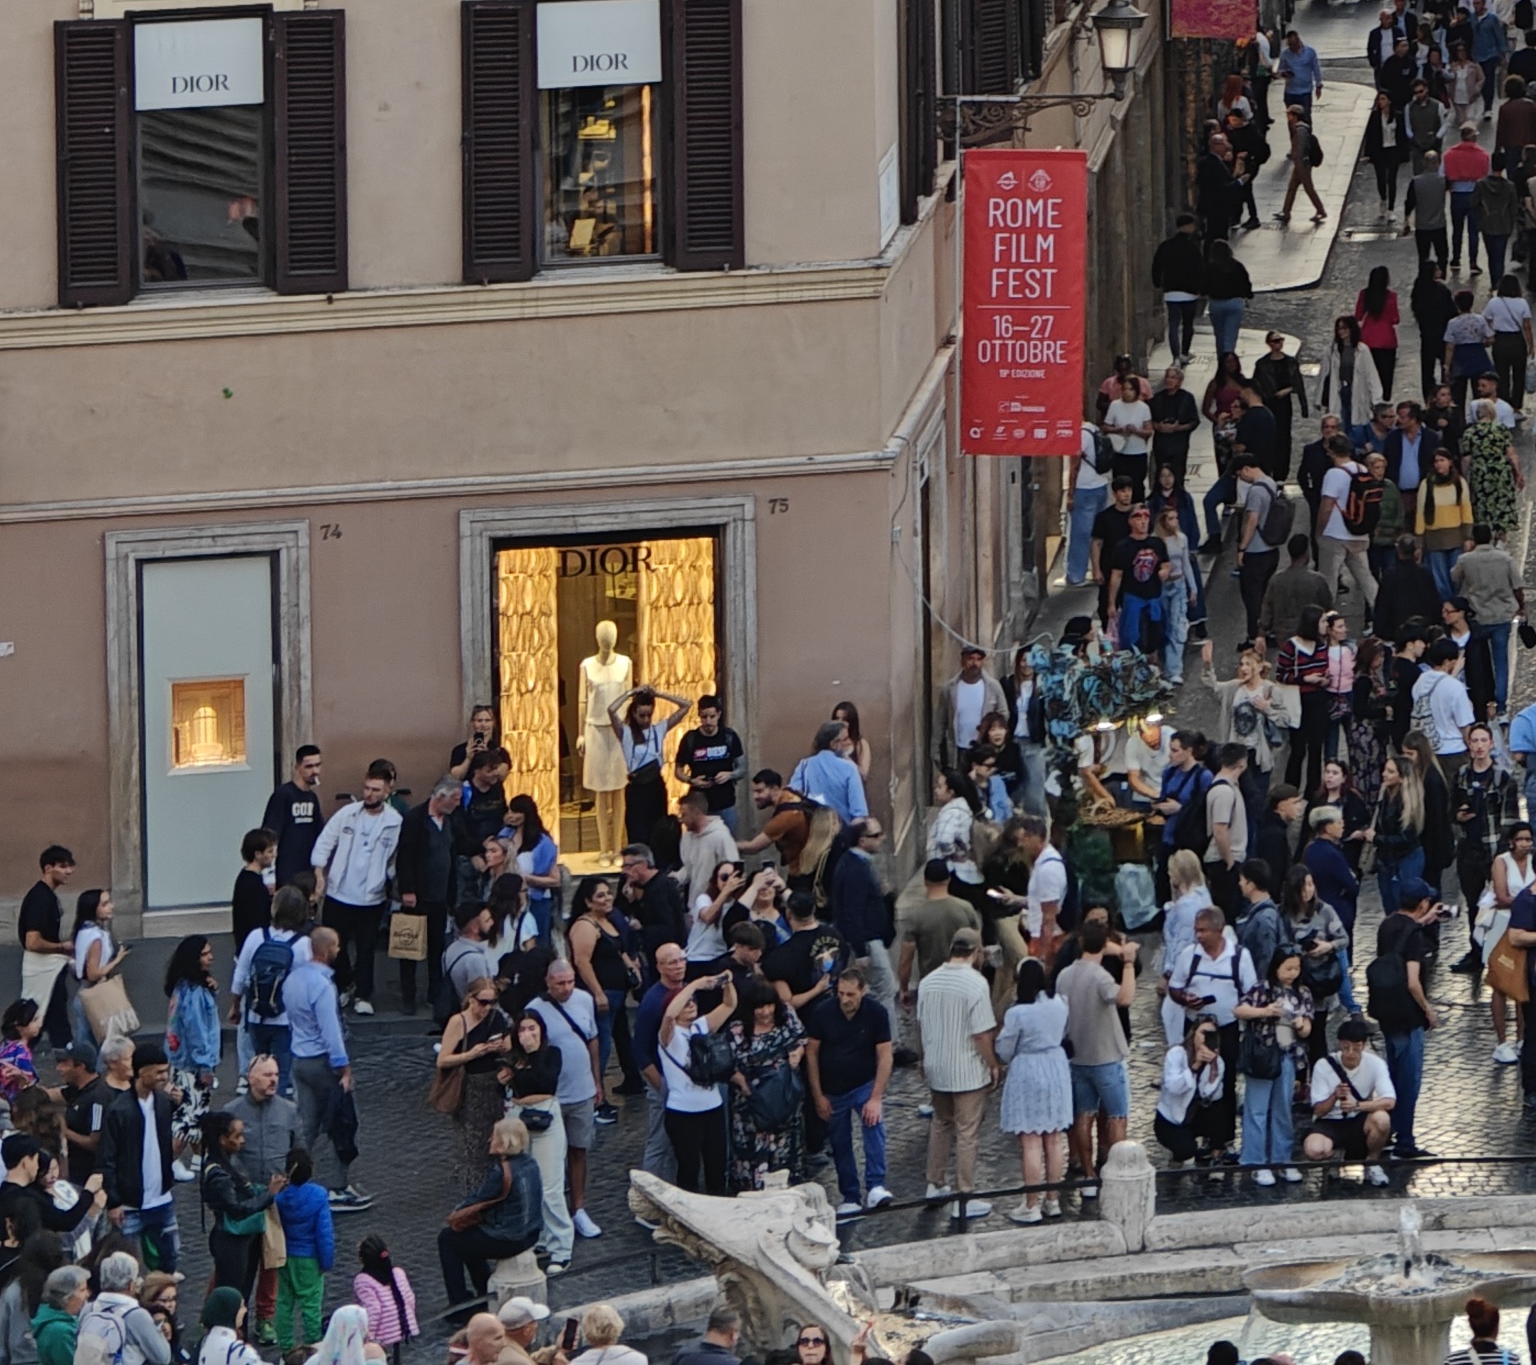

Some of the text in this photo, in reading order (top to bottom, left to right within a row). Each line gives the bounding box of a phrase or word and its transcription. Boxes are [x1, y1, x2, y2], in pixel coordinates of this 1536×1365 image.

[571, 52, 629, 73] DIOR
[171, 73, 230, 94] DIOR
[988, 197, 1063, 228] ROME
[994, 233, 1055, 263] FILM
[991, 268, 1058, 298] FEST
[977, 339, 1069, 364] OTTOBRE
[768, 497, 789, 516] 75
[319, 523, 342, 541] 74
[557, 546, 655, 579] DIOR
